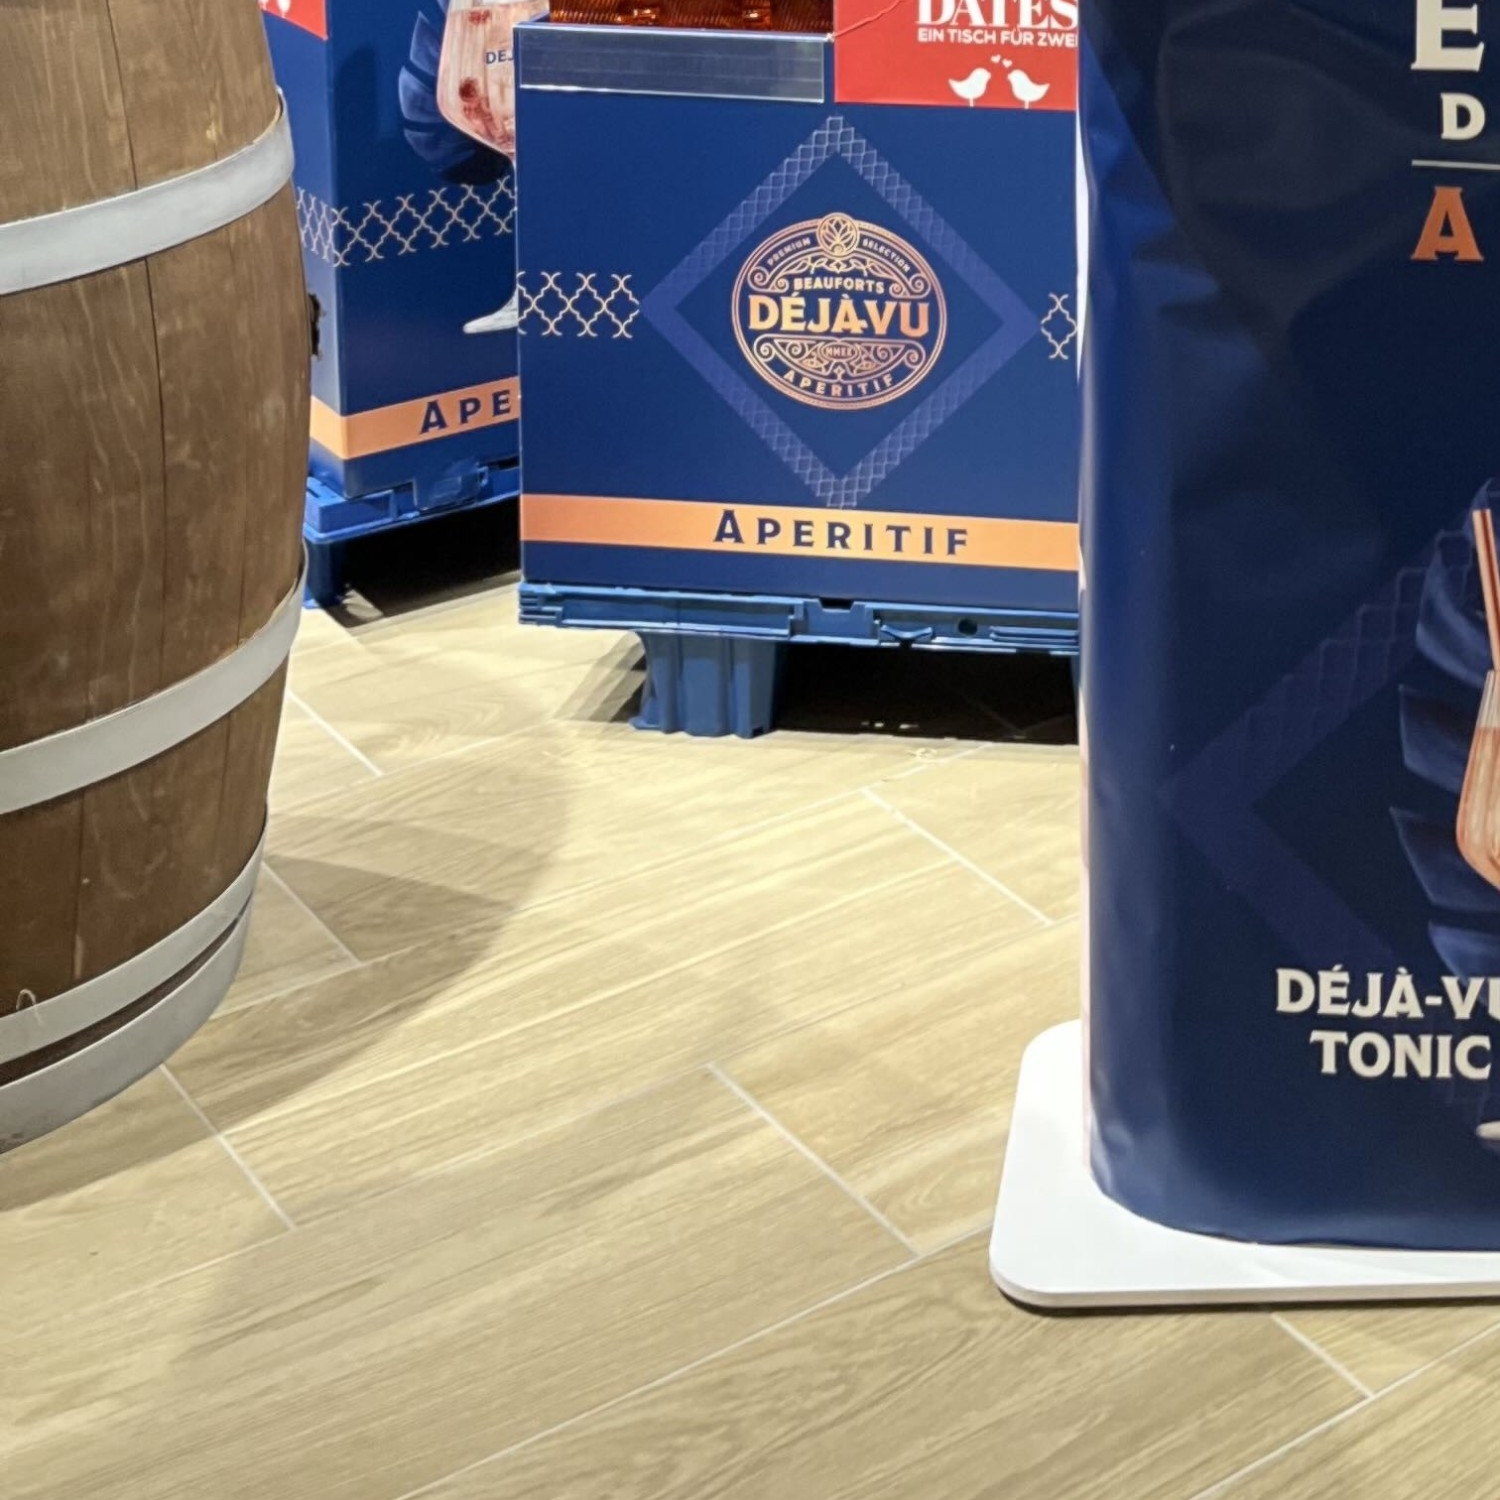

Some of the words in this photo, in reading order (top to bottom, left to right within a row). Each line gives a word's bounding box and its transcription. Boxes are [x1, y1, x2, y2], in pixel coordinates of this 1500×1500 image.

[917, 27, 944, 43] EIN
[947, 28, 997, 45] TISCH
[1000, 26, 1034, 46] FÜR
[766, 236, 812, 267] PREMIUM
[862, 237, 912, 274] SELECTION
[793, 276, 885, 295] BEAUFORTS
[783, 369, 894, 398] APERITIF
[712, 508, 969, 556] APERITIF
[1309, 1029, 1492, 1080] TONIC
